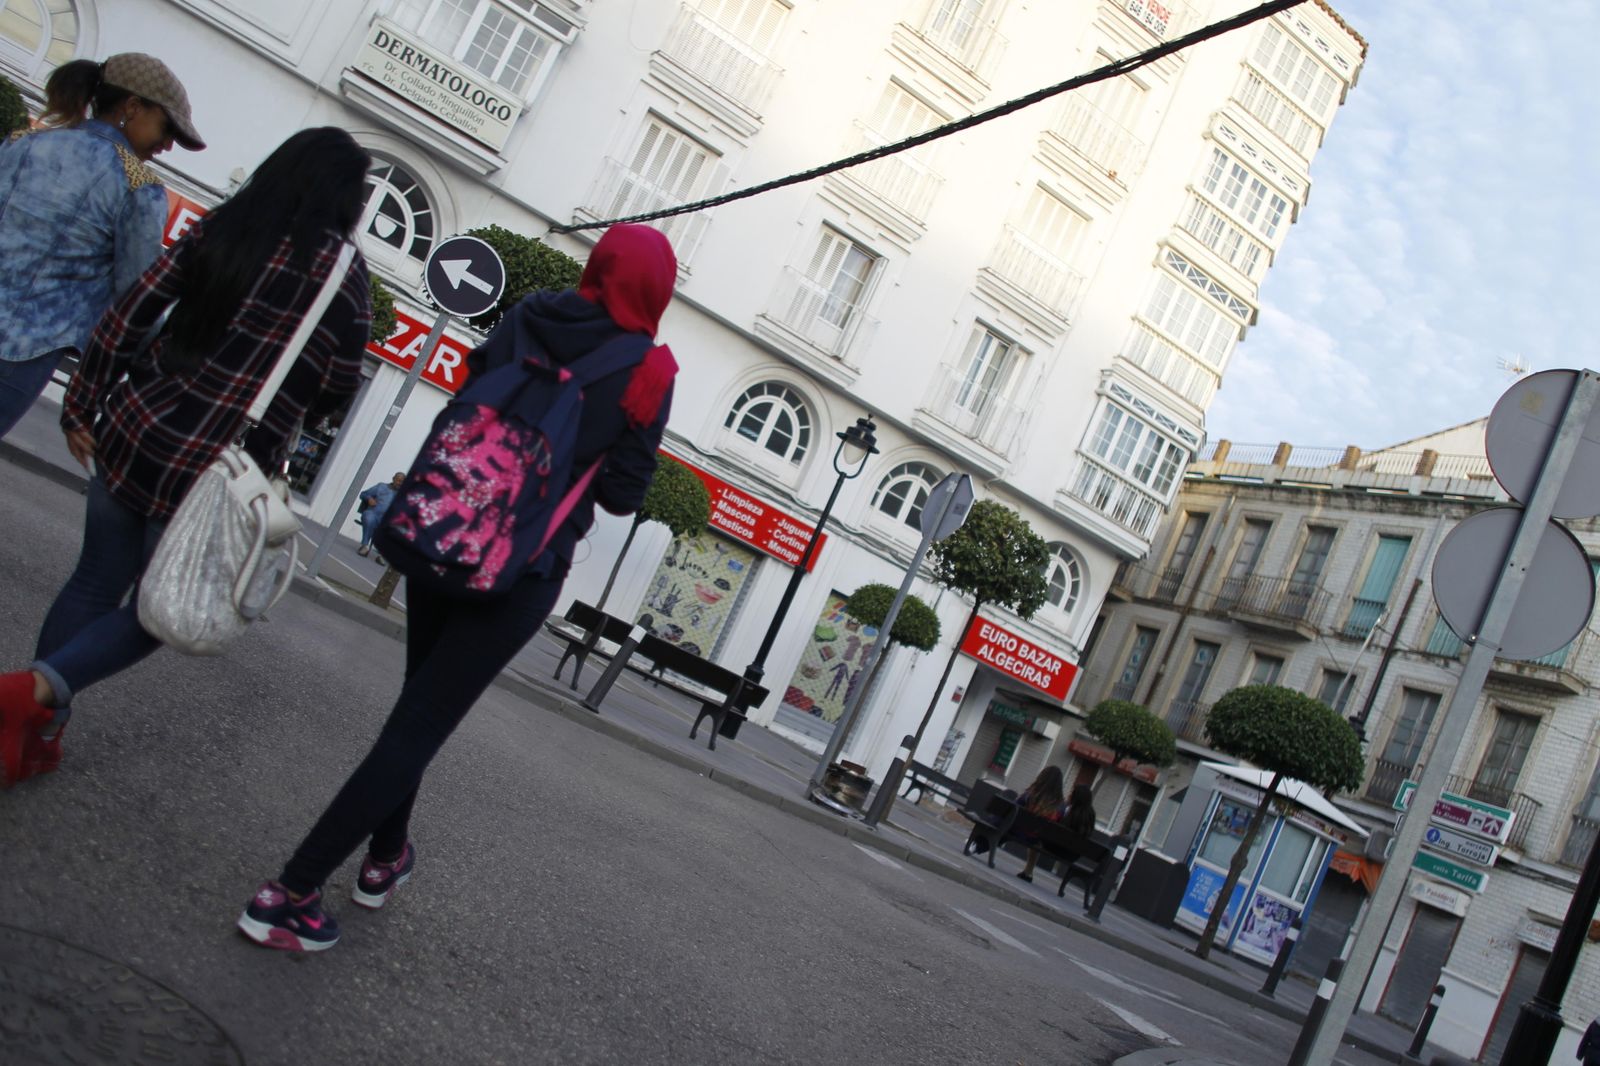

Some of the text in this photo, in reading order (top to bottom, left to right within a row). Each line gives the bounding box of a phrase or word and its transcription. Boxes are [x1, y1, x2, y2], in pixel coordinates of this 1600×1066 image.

[373, 30, 512, 122] DERMATOLOGO
[384, 61, 485, 126] Dr. Collado Minguillón
[383, 73, 478, 134] Dr. Delgado Ceballos
[717, 500, 756, 525] Mascota
[722, 488, 764, 516] Limpieza
[767, 540, 800, 563] Menaje
[977, 644, 1051, 689] ALGECIRAS
[979, 623, 1062, 676] EURO BAZAR
[1453, 869, 1477, 885] Tarifa
